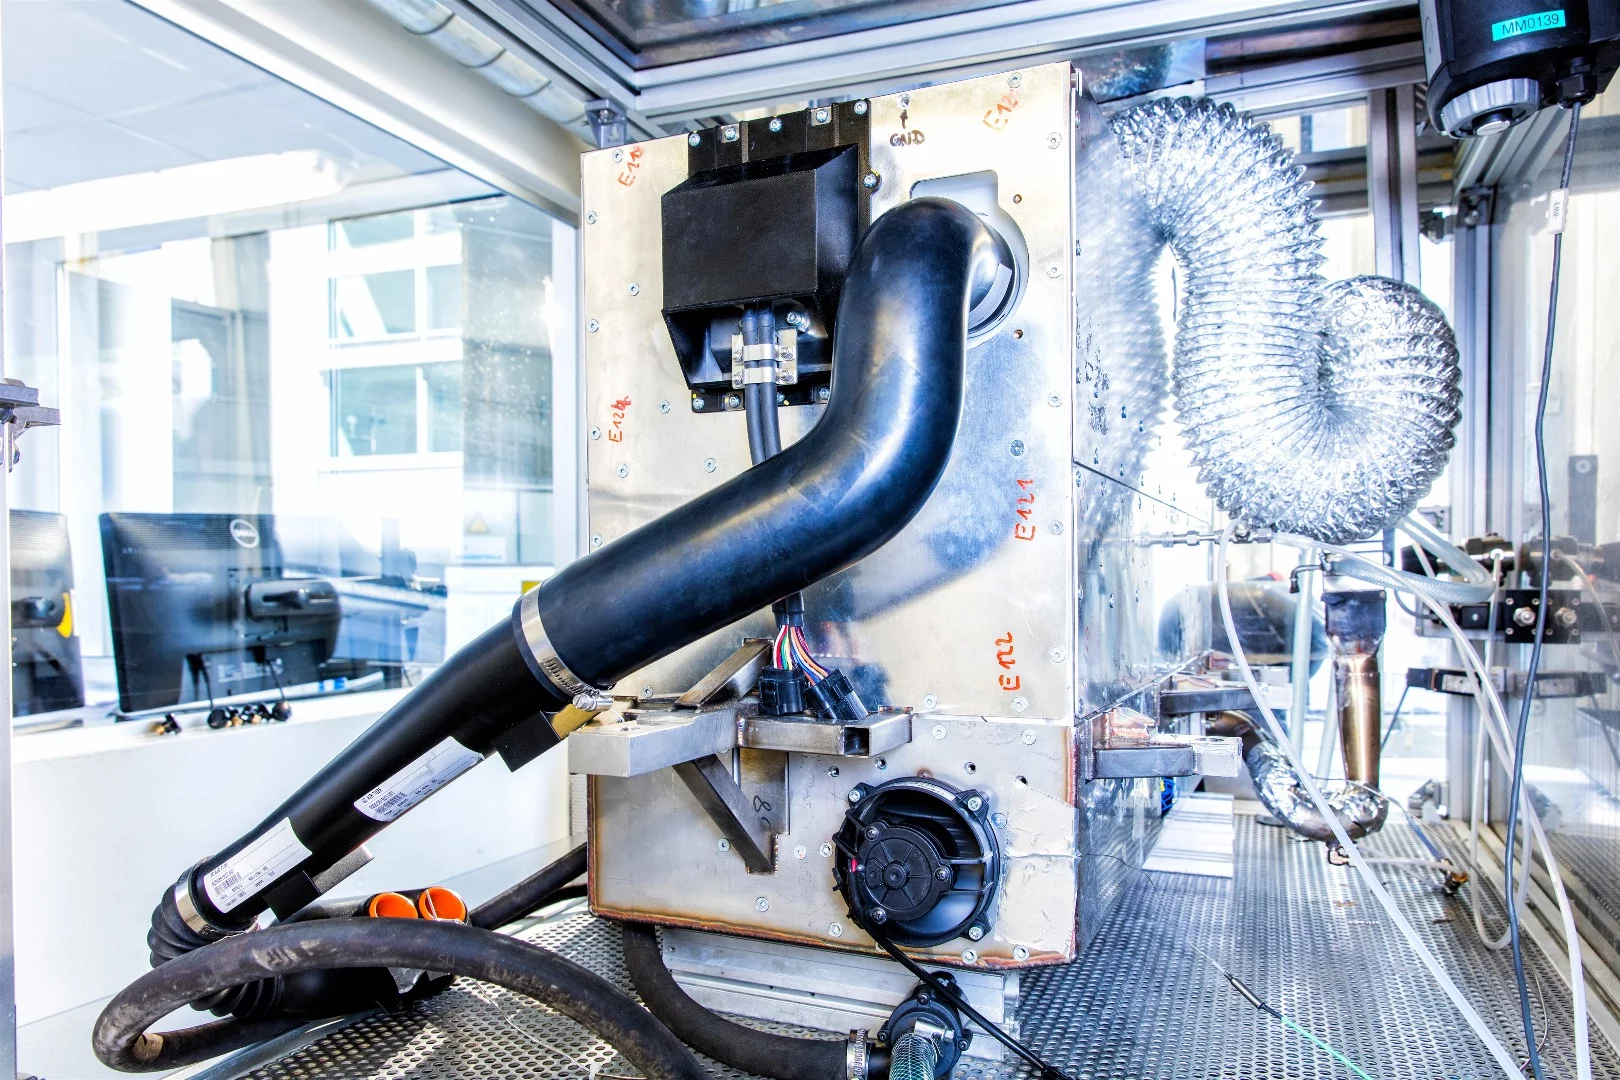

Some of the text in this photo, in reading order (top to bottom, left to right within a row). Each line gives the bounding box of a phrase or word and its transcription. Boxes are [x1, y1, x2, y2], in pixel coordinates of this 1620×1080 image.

[1502, 13, 1560, 36] MM0139
[889, 129, 926, 147] GND
[1015, 479, 1036, 541] E121
[995, 631, 1021, 691] E122
